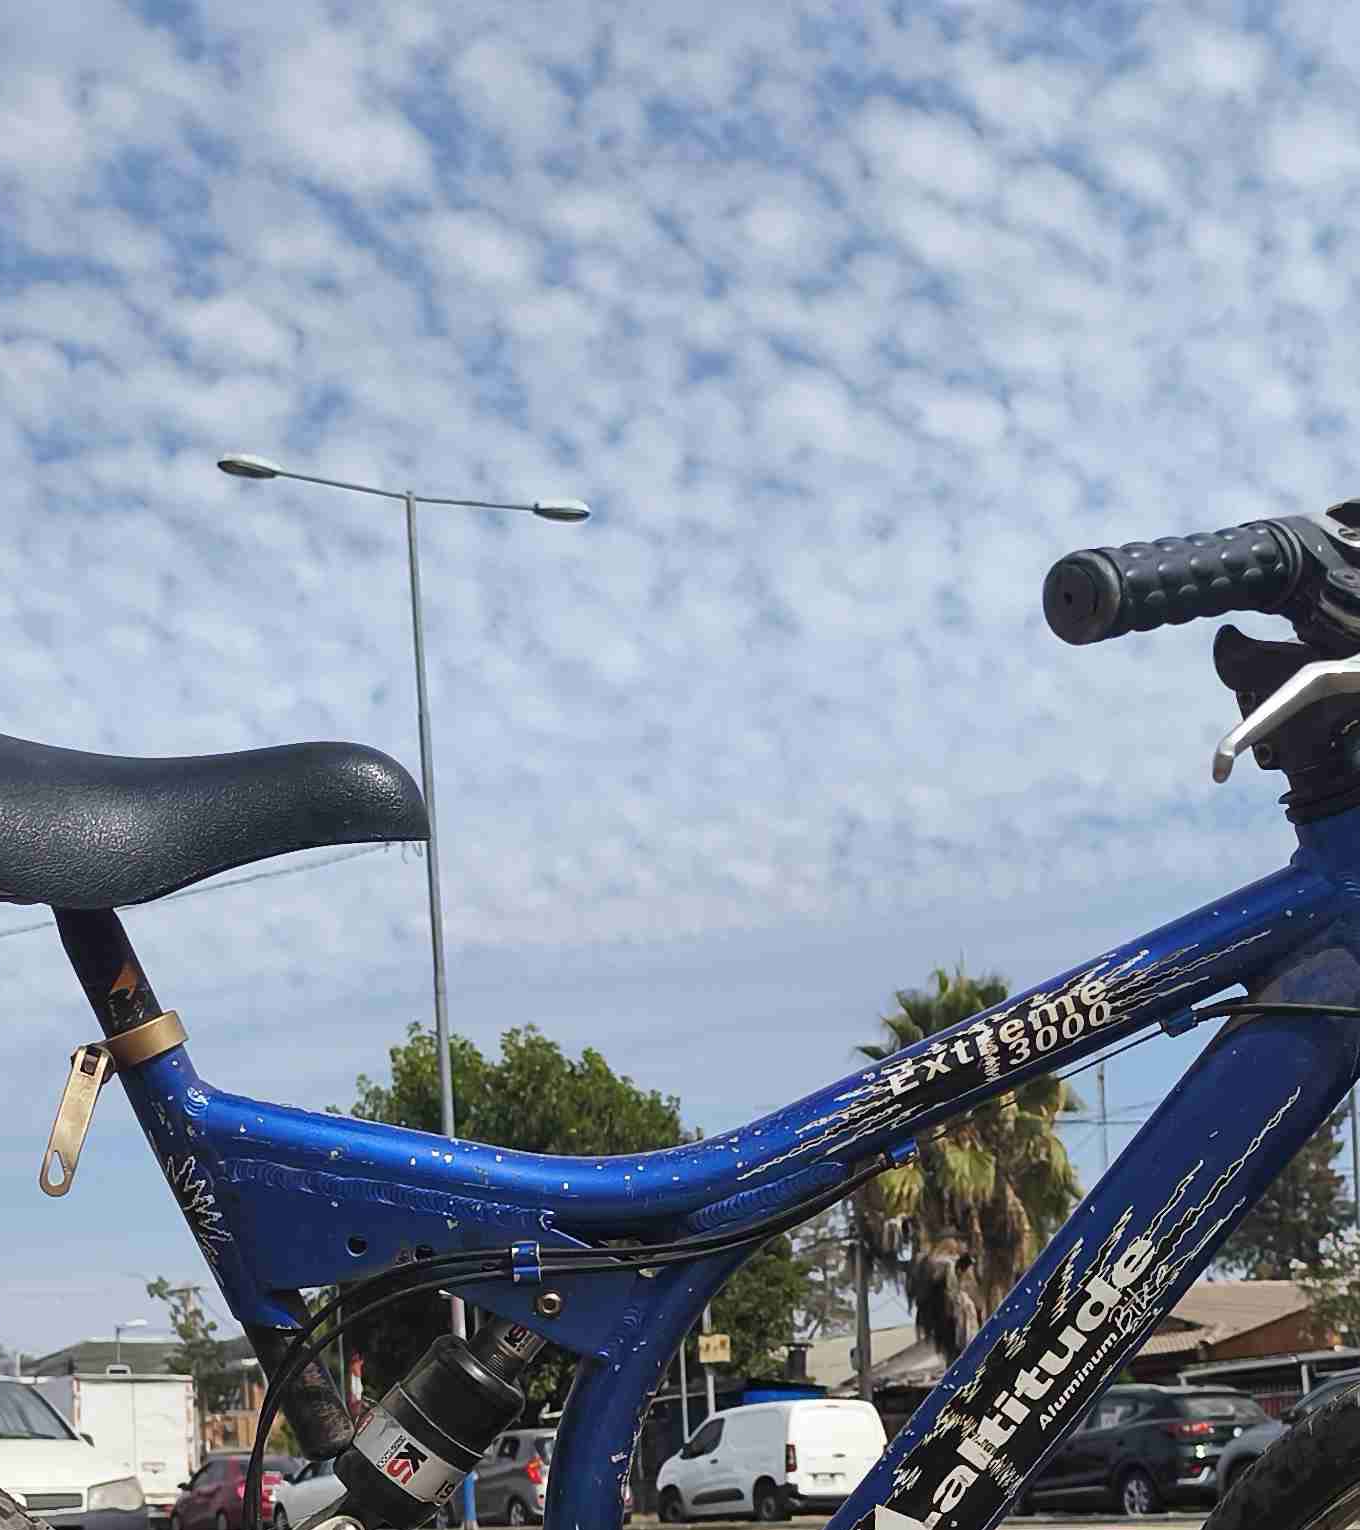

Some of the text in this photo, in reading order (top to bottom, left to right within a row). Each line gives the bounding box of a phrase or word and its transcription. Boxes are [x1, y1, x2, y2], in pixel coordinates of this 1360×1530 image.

[888, 976, 1108, 1097] Extreme
[1008, 1000, 1113, 1066] 3000
[1039, 1332, 1119, 1431] Aluminum
